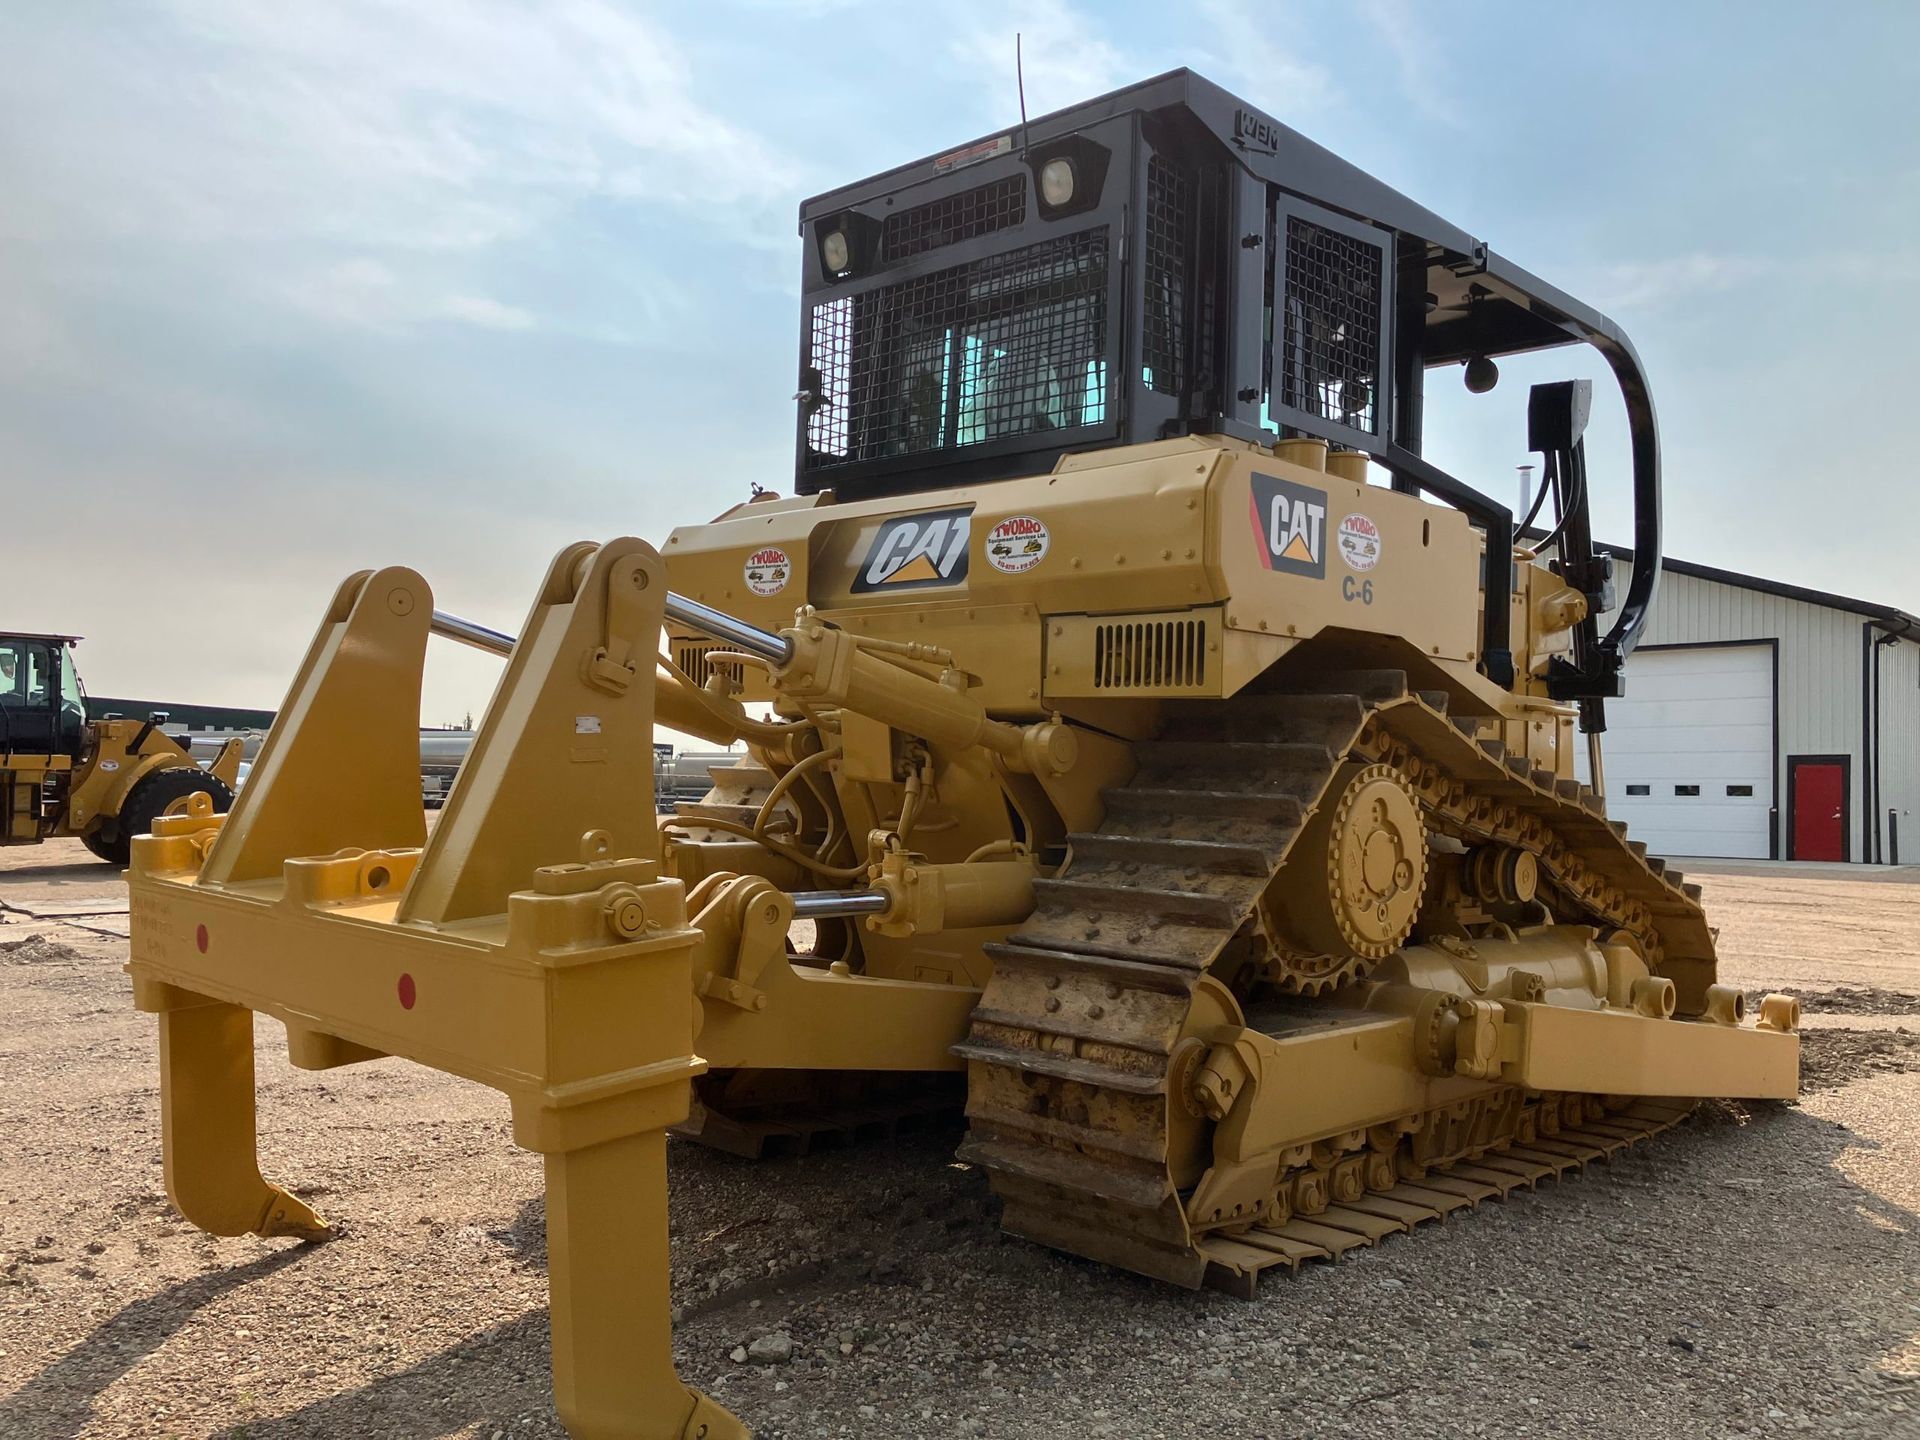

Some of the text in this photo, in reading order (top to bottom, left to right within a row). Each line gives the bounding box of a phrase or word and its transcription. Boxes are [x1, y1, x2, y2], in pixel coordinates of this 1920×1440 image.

[995, 519, 1042, 538] TWOBRO
[1270, 494, 1325, 564] CAT
[1344, 517, 1375, 536] TWOBRO
[751, 550, 785, 564] TWOBRO
[866, 517, 970, 584] CAT
[1342, 575, 1373, 605] C-6
